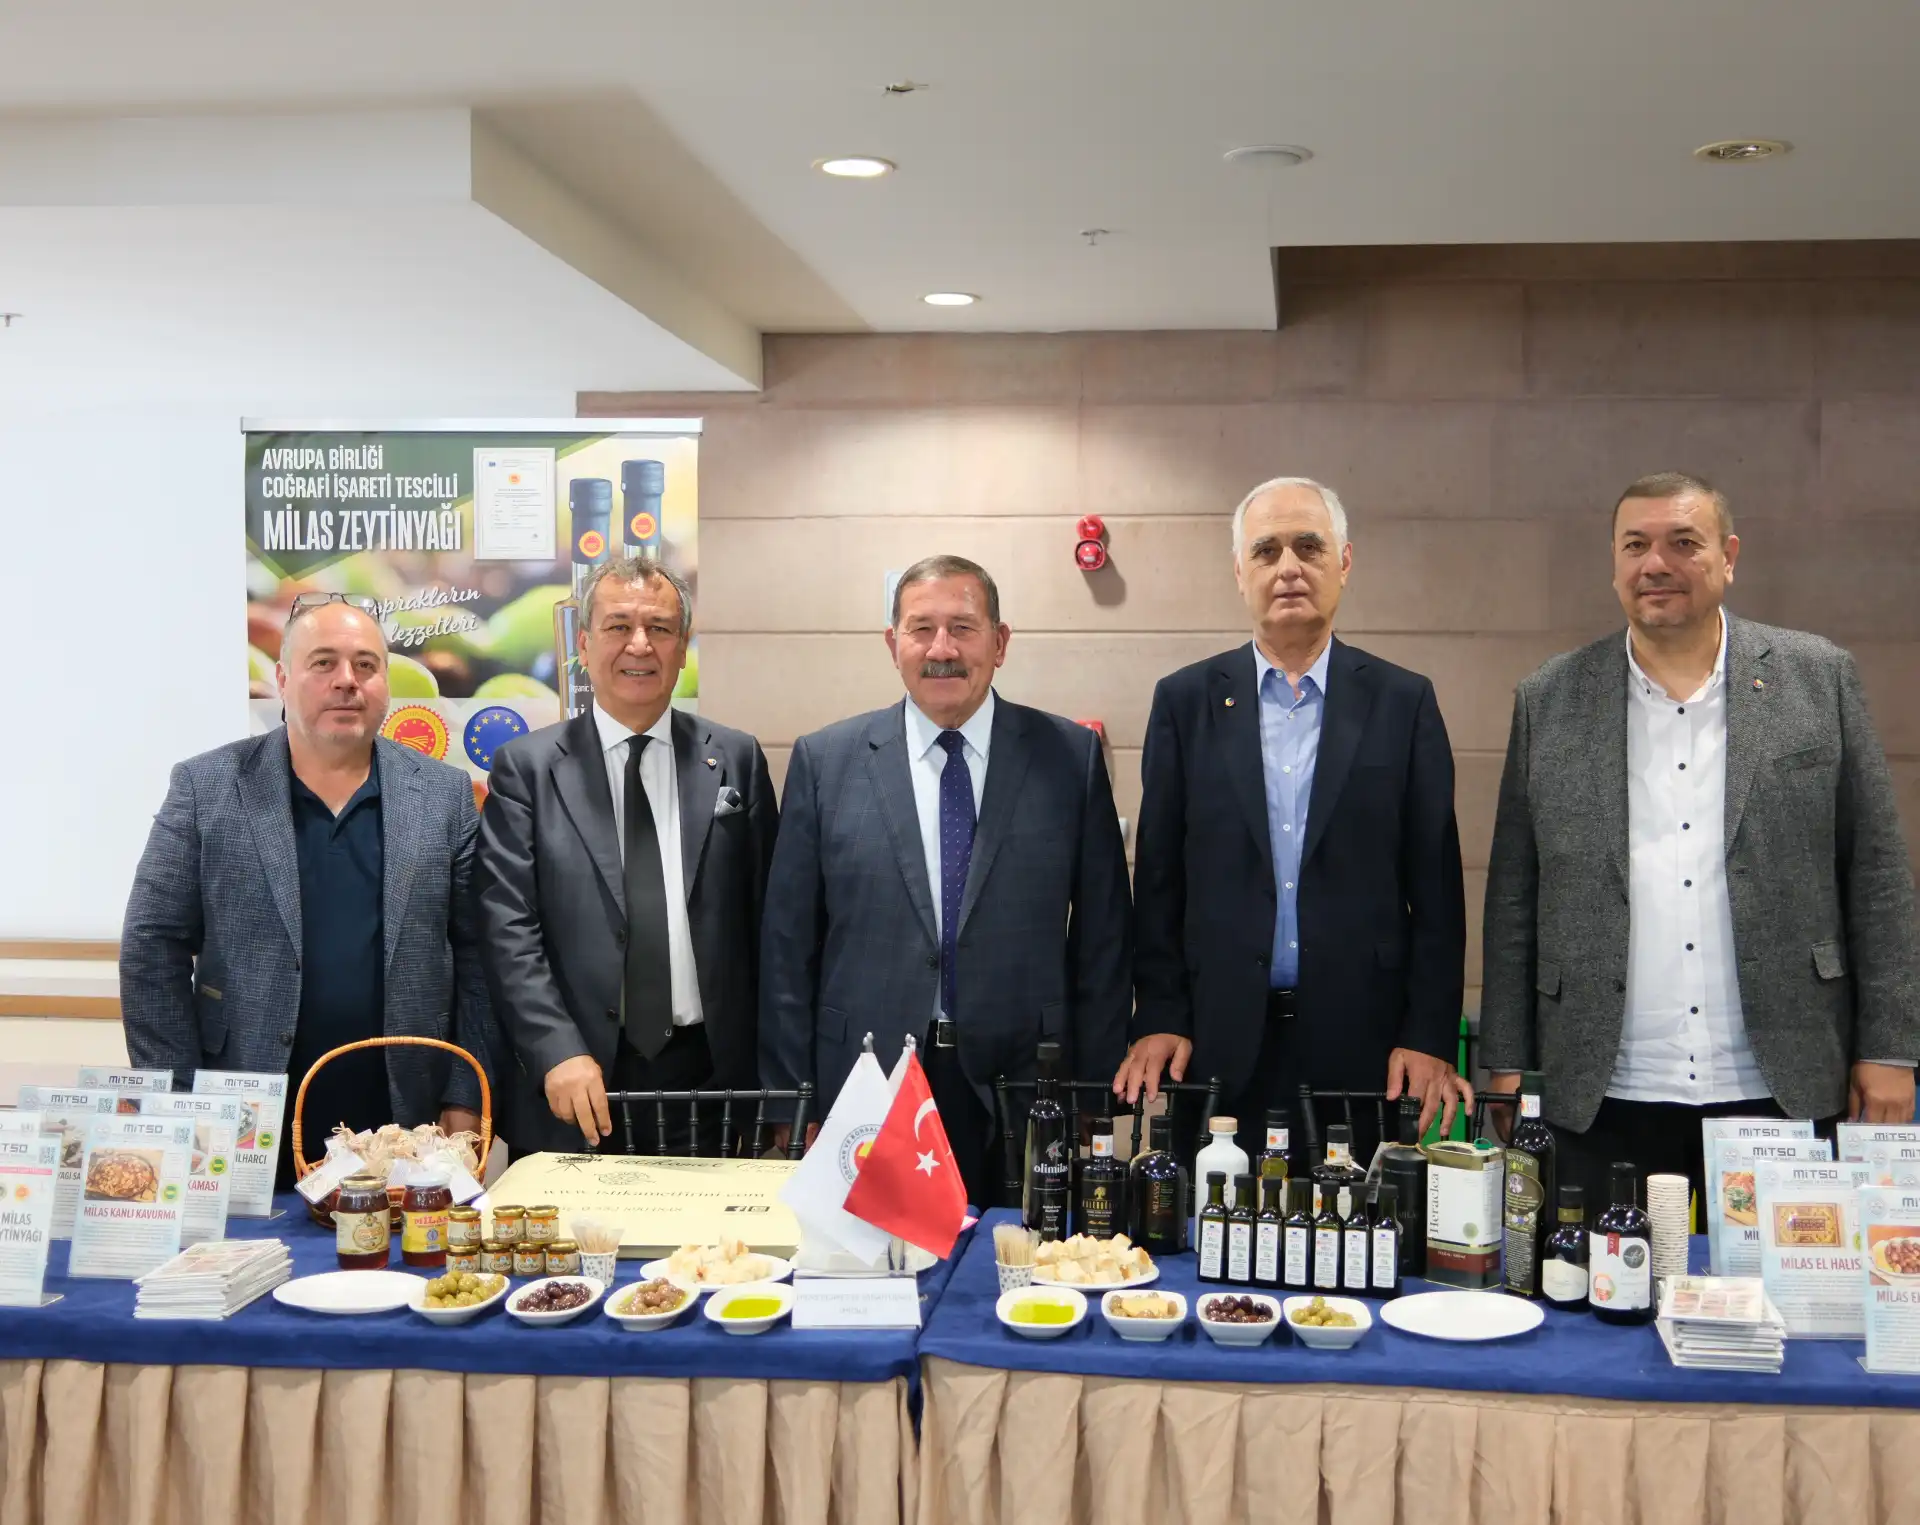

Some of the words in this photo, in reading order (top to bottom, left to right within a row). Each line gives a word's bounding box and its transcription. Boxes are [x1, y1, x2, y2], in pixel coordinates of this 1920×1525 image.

[261, 448, 326, 470] AVRUPA
[329, 445, 383, 470] BİRLİĞİ
[262, 473, 330, 498] COĞRAFİ
[334, 473, 392, 502] İŞARETİ
[395, 473, 458, 498] TESCİLLİ
[263, 503, 334, 550] MİLAS
[339, 502, 461, 550] ZEYTİNYAĞI
[391, 615, 479, 647] lezzetleri
[136, 1208, 176, 1220] KAVURMA
[1429, 1173, 1440, 1234] Heraclea
[1, 1209, 32, 1225] MİLAS
[1781, 1255, 1814, 1270] MİLAS
[1816, 1258, 1828, 1270] EL
[1876, 1287, 1908, 1303] MİLAS
